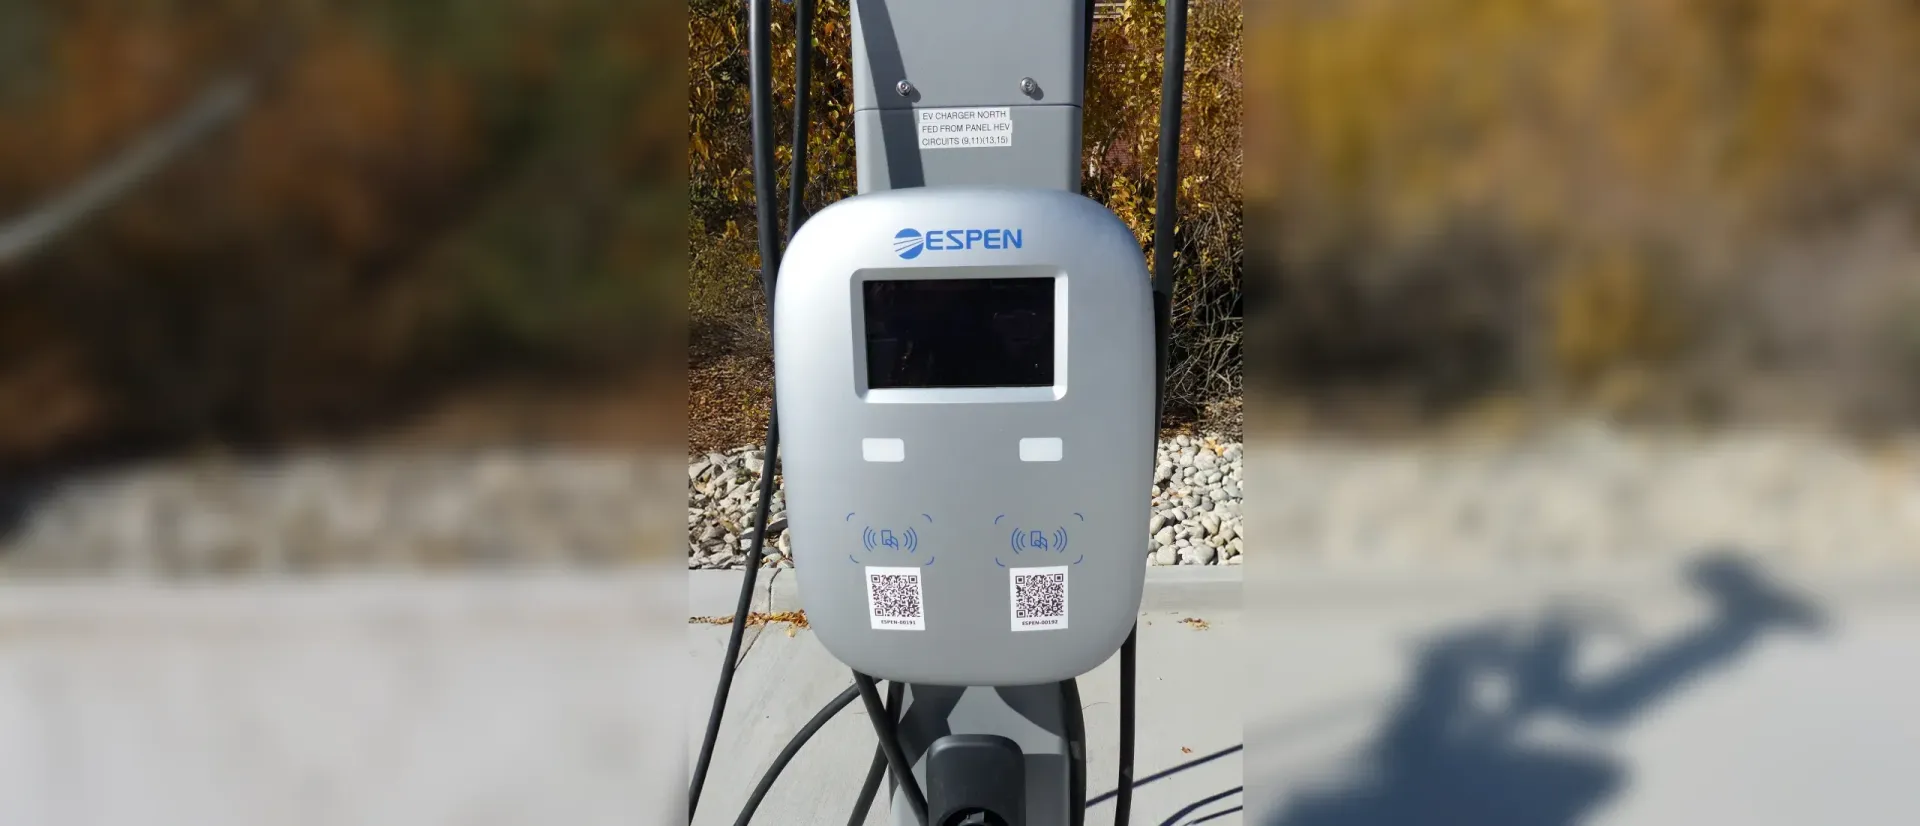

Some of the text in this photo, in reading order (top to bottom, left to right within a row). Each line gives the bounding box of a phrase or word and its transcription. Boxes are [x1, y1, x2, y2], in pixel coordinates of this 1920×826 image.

[922, 110, 1006, 120] EV CHARGER NORTH
[922, 123, 1010, 133] FED FROM PANEL HEV
[922, 137, 960, 146] CIRCUITS
[925, 228, 1022, 250] ESPEN
